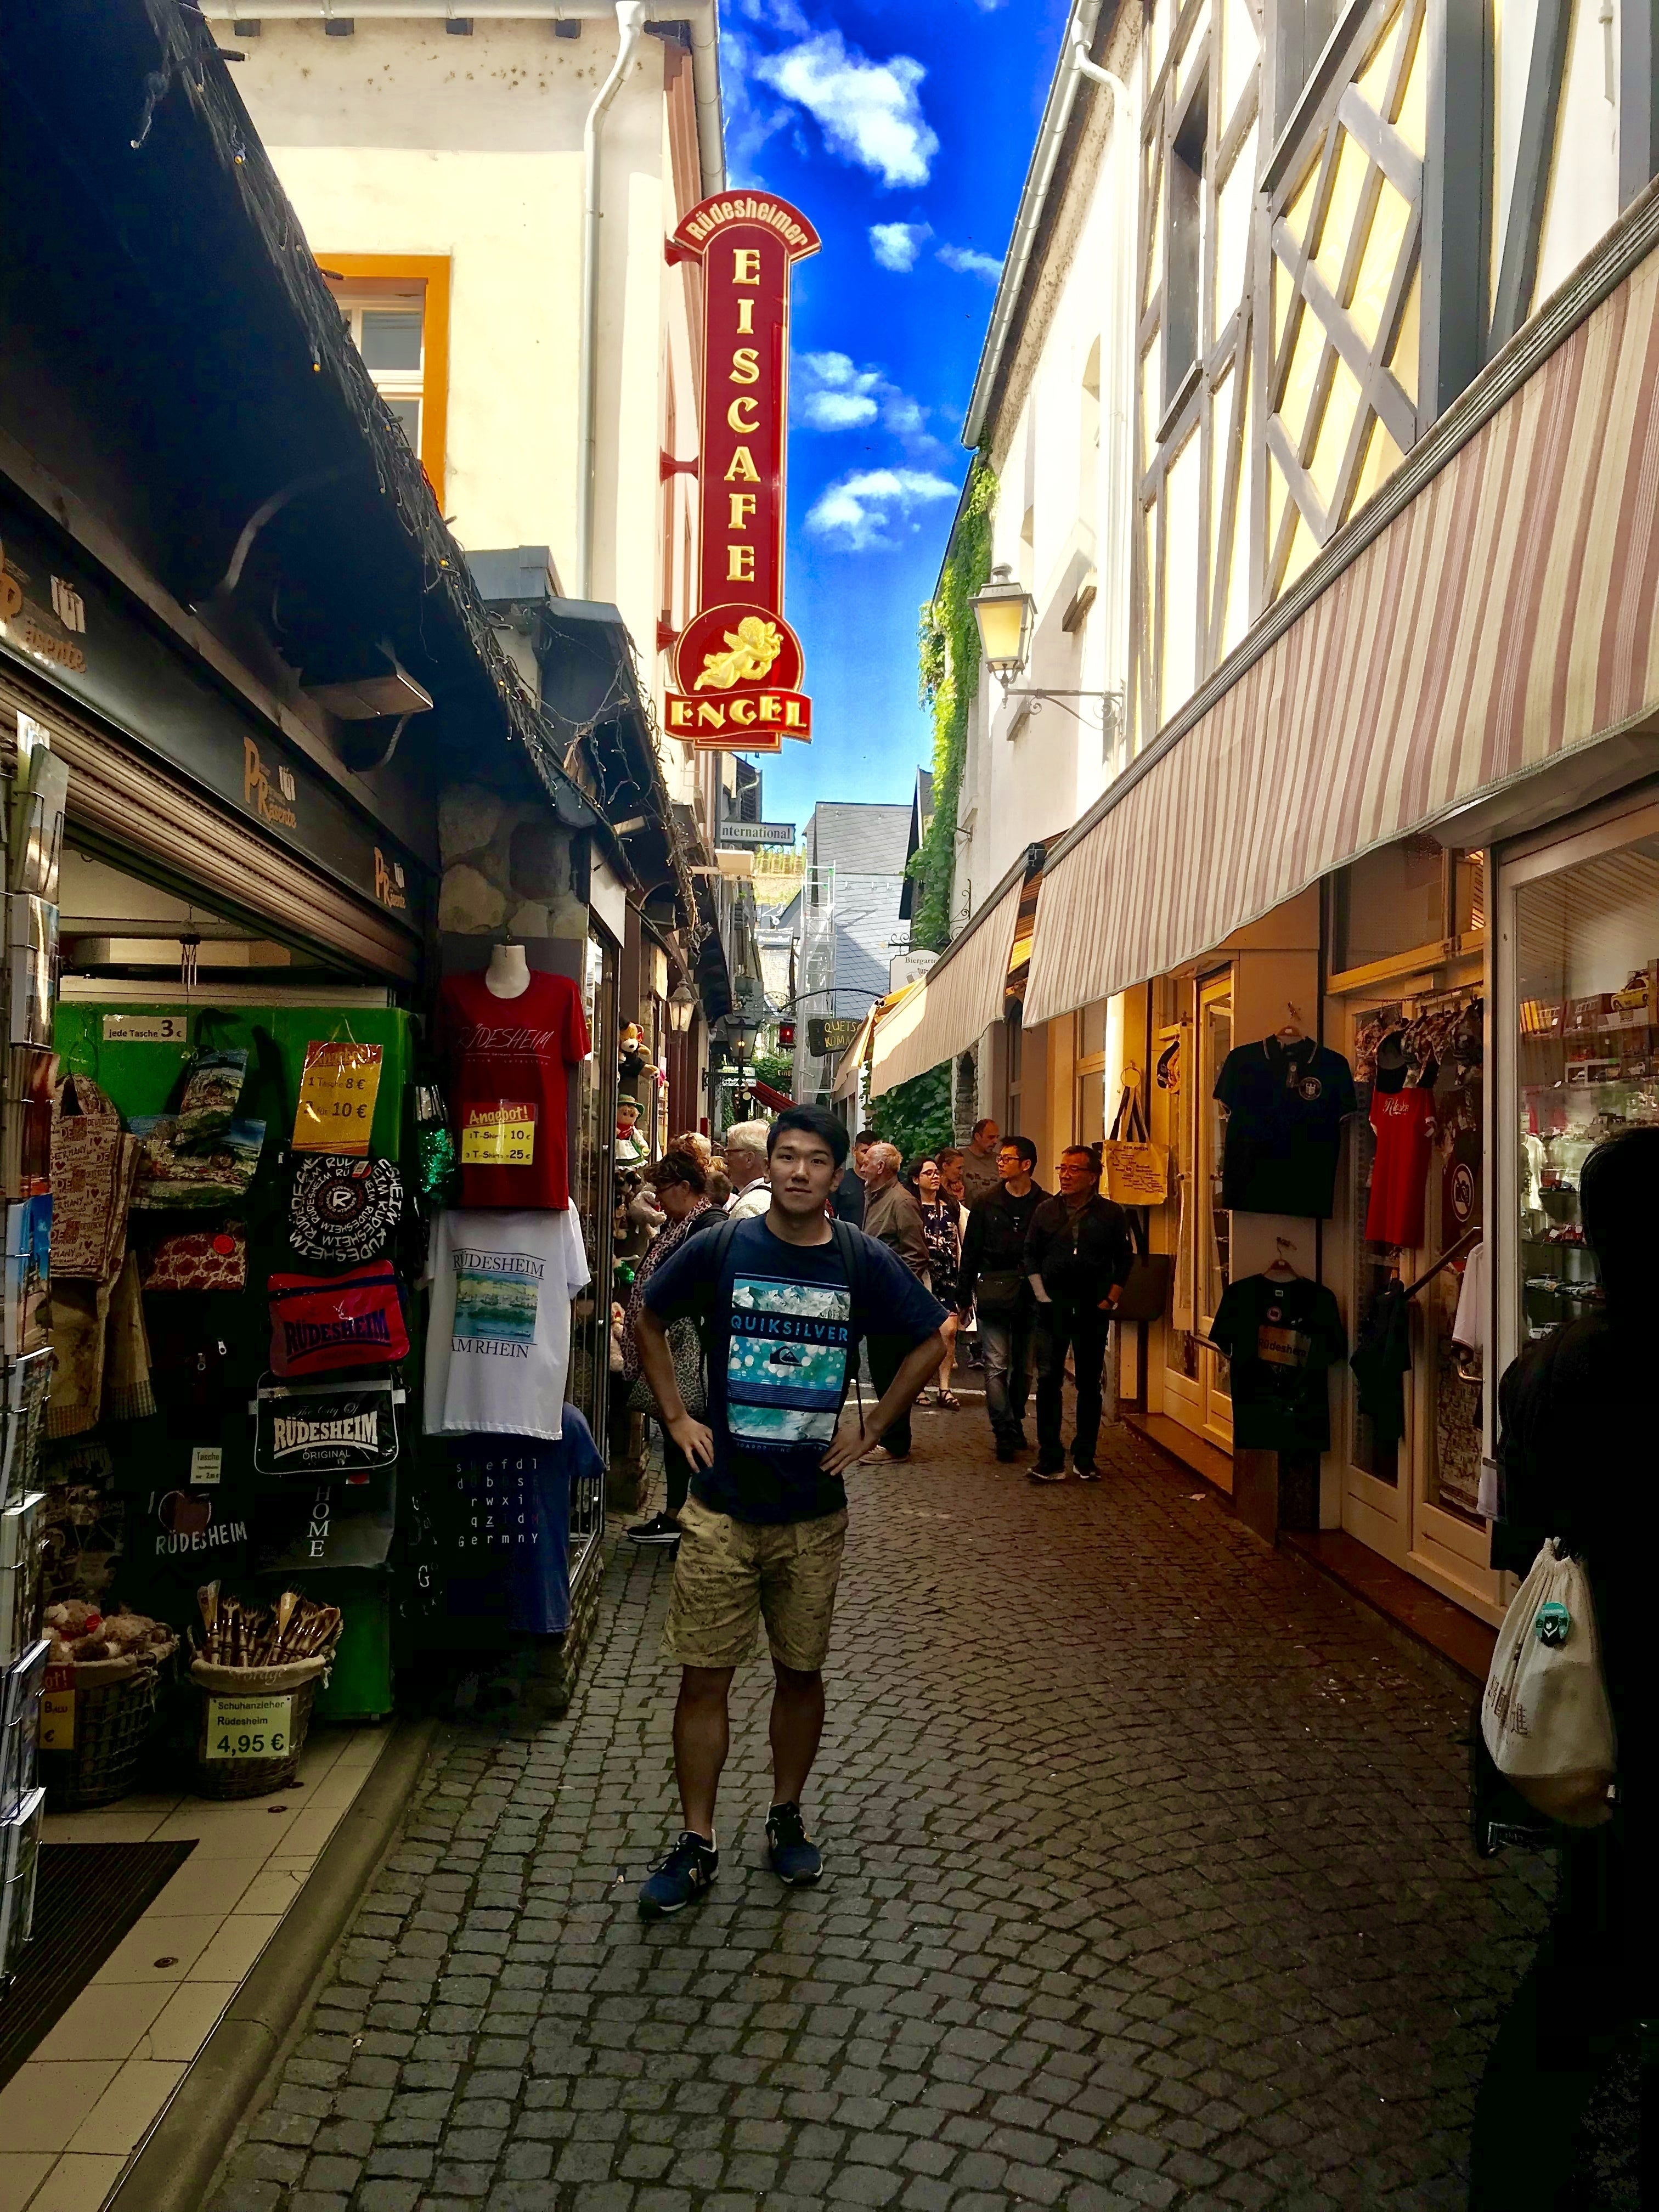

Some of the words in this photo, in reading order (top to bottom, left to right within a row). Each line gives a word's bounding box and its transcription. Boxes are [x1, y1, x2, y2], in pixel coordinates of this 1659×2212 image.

[685, 198, 808, 245] Rüdesheimer
[724, 248, 761, 582] EISCAFE
[671, 696, 808, 729] ENGEL
[721, 826, 791, 839] nternational
[905, 957, 937, 965] Biergarte
[109, 1029, 127, 1038] jede
[161, 1019, 173, 1037] 3
[458, 1023, 555, 1051] RÜDESHEIM
[308, 1077, 314, 1086] 1
[345, 1078, 354, 1090] 8
[357, 1079, 365, 1090] €
[331, 1102, 353, 1118] 10
[357, 1104, 368, 1119] €
[470, 1105, 528, 1125] Angebot!
[511, 1130, 524, 1140] 10
[510, 1149, 524, 1159] 25
[332, 1190, 352, 1207] R
[453, 1251, 544, 1277] RÜDESHEIM
[283, 1308, 391, 1358] RÜDESHEIM
[730, 1315, 848, 1342] QUIKSILVER
[476, 1340, 529, 1358] RHEIN
[274, 1410, 379, 1452] RÜDESHEIM
[302, 1449, 351, 1460] ORIGINAL
[307, 1485, 331, 1558] HOME
[156, 1521, 247, 1555] RÜDESHEIM
[44, 1669, 67, 1689] ot!
[218, 1701, 285, 1710] Schuhanzieher
[217, 1716, 268, 1725] Rüdesheim
[44, 1729, 54, 1742] €
[217, 1734, 264, 1756] 4,95
[271, 1733, 284, 1751] €
